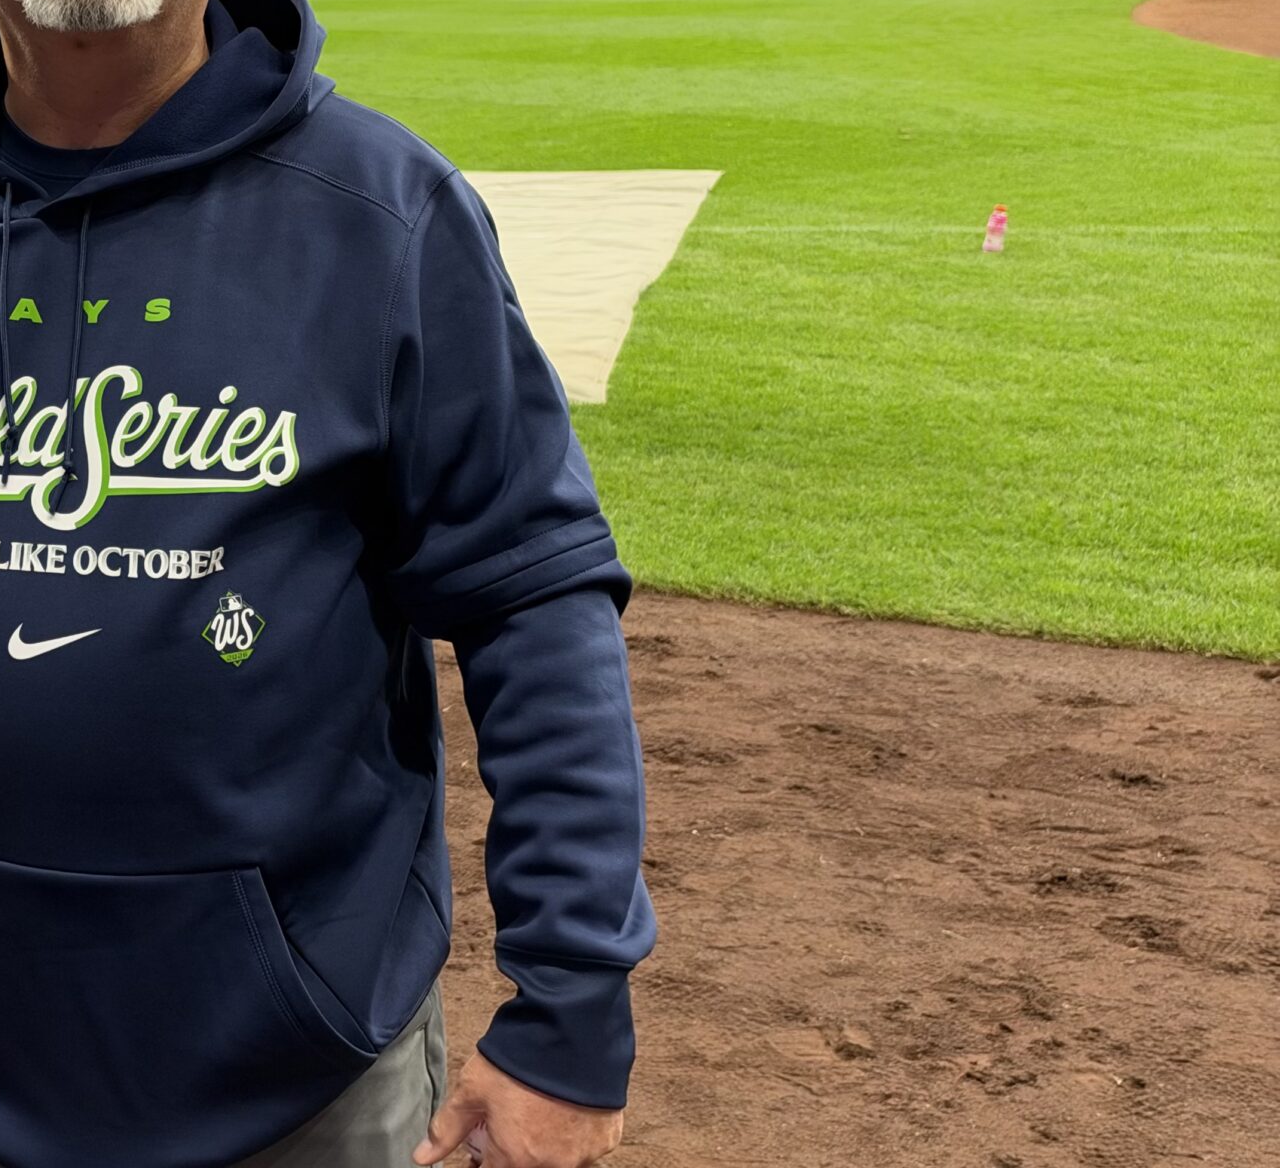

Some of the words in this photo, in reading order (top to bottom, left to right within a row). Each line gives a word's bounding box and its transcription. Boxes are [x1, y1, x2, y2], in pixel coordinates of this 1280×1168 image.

[30, 364, 300, 532] Series
[72, 545, 225, 581] OCTOBER
[210, 607, 255, 652] WS
